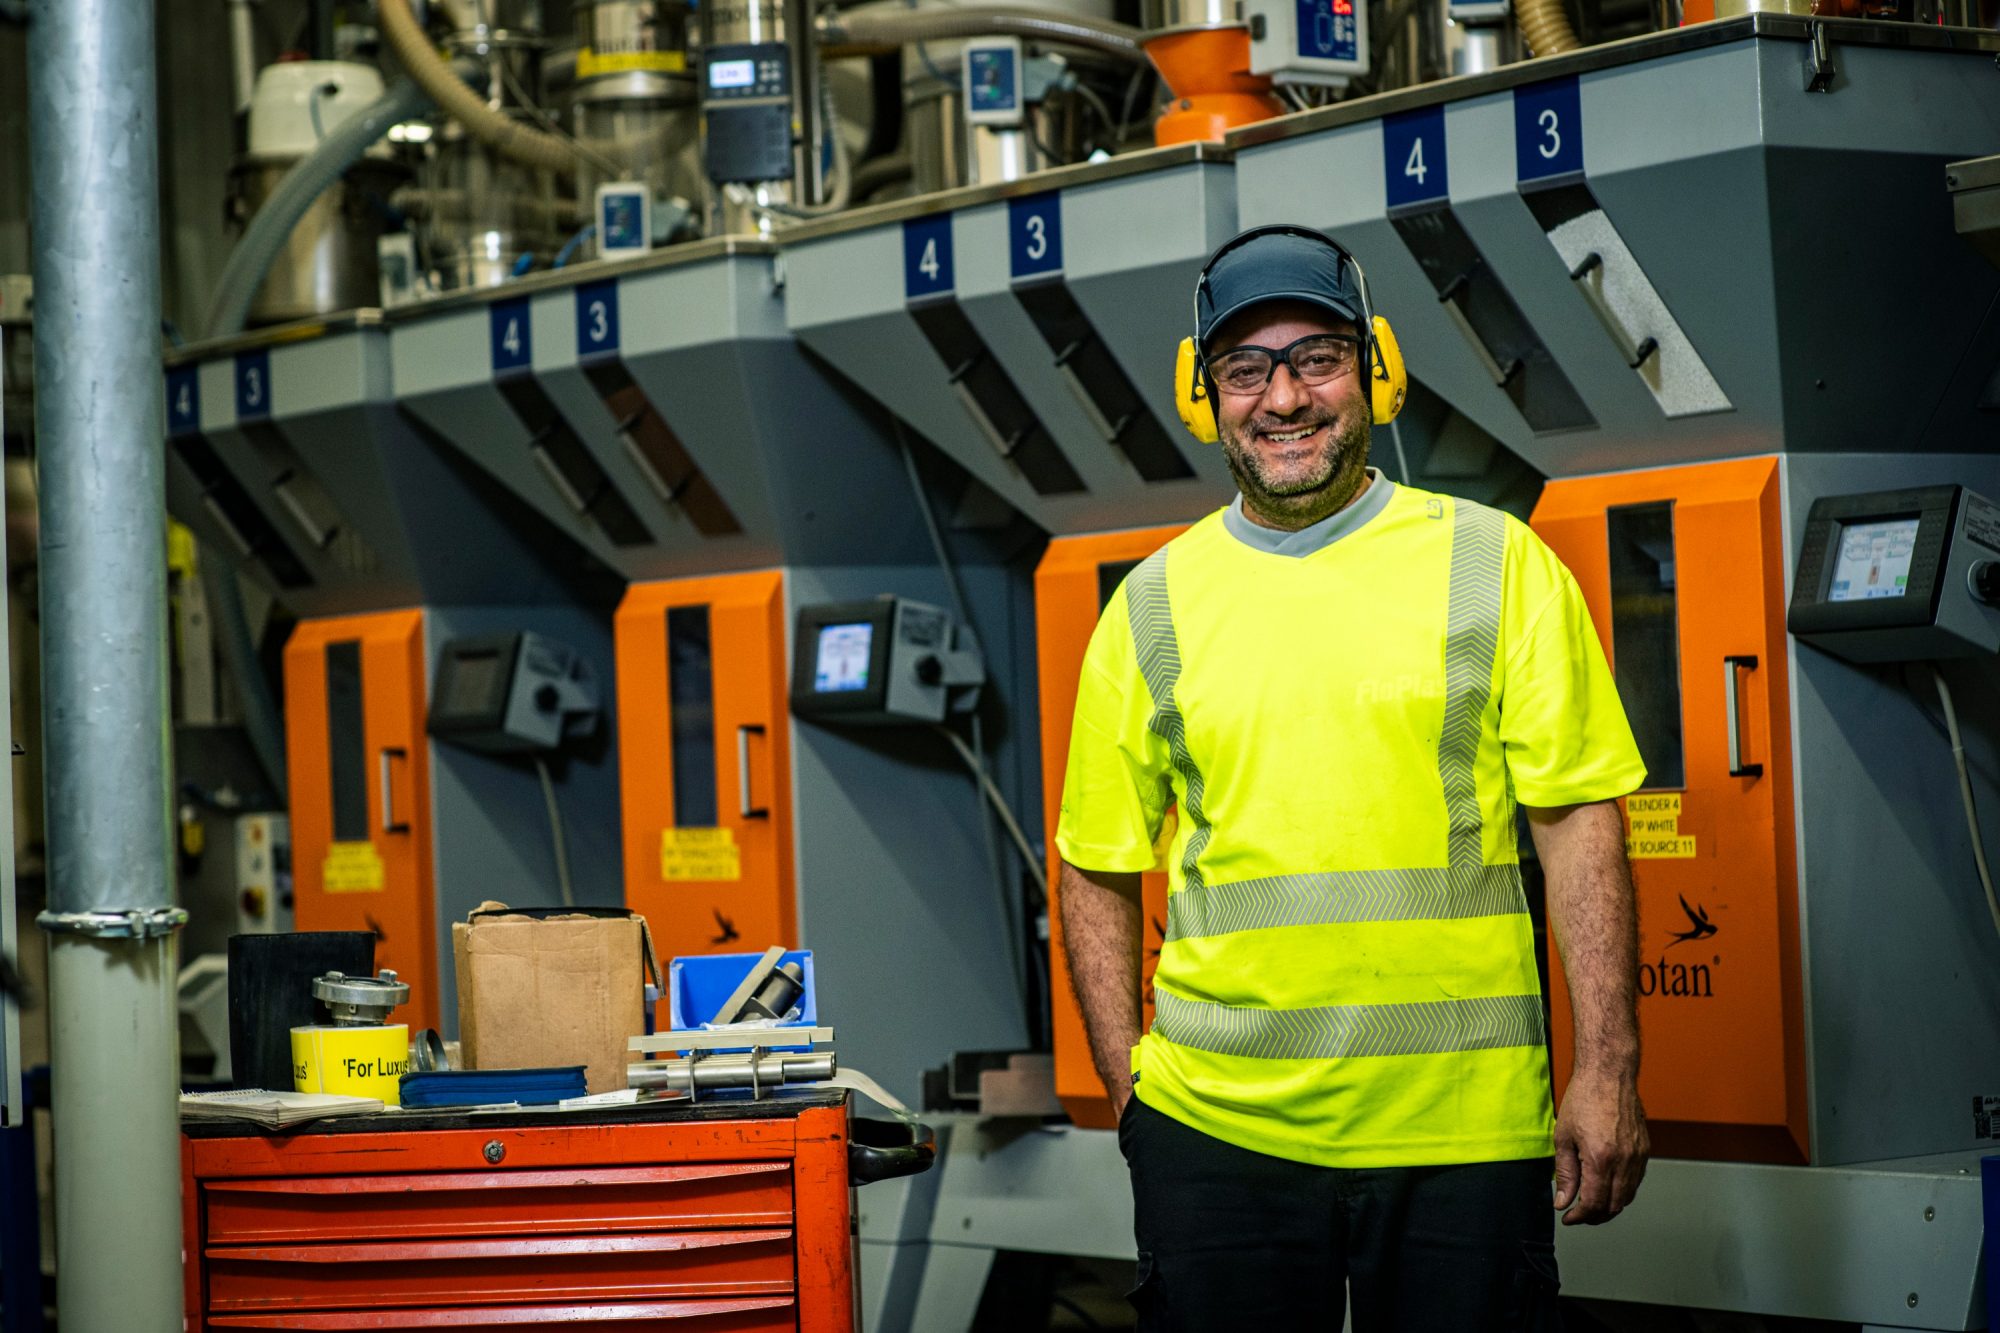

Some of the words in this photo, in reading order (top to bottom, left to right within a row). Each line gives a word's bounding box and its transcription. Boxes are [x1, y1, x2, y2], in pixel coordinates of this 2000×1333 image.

[1538, 109, 1561, 159] 3
[1404, 137, 1427, 185] 4
[1026, 214, 1047, 260] 3
[919, 237, 939, 280] 4
[503, 318, 519, 354] 4
[589, 300, 608, 342] 3
[176, 382, 190, 416] 4
[246, 367, 262, 407] 3
[1628, 798, 1670, 812] BLENDER
[1673, 798, 1680, 810] 4
[1632, 820, 1644, 832] PP
[1647, 818, 1676, 832] WHITE
[1639, 840, 1680, 854] SOURCE
[1682, 839, 1693, 853] 11
[1639, 954, 1714, 997] otan
